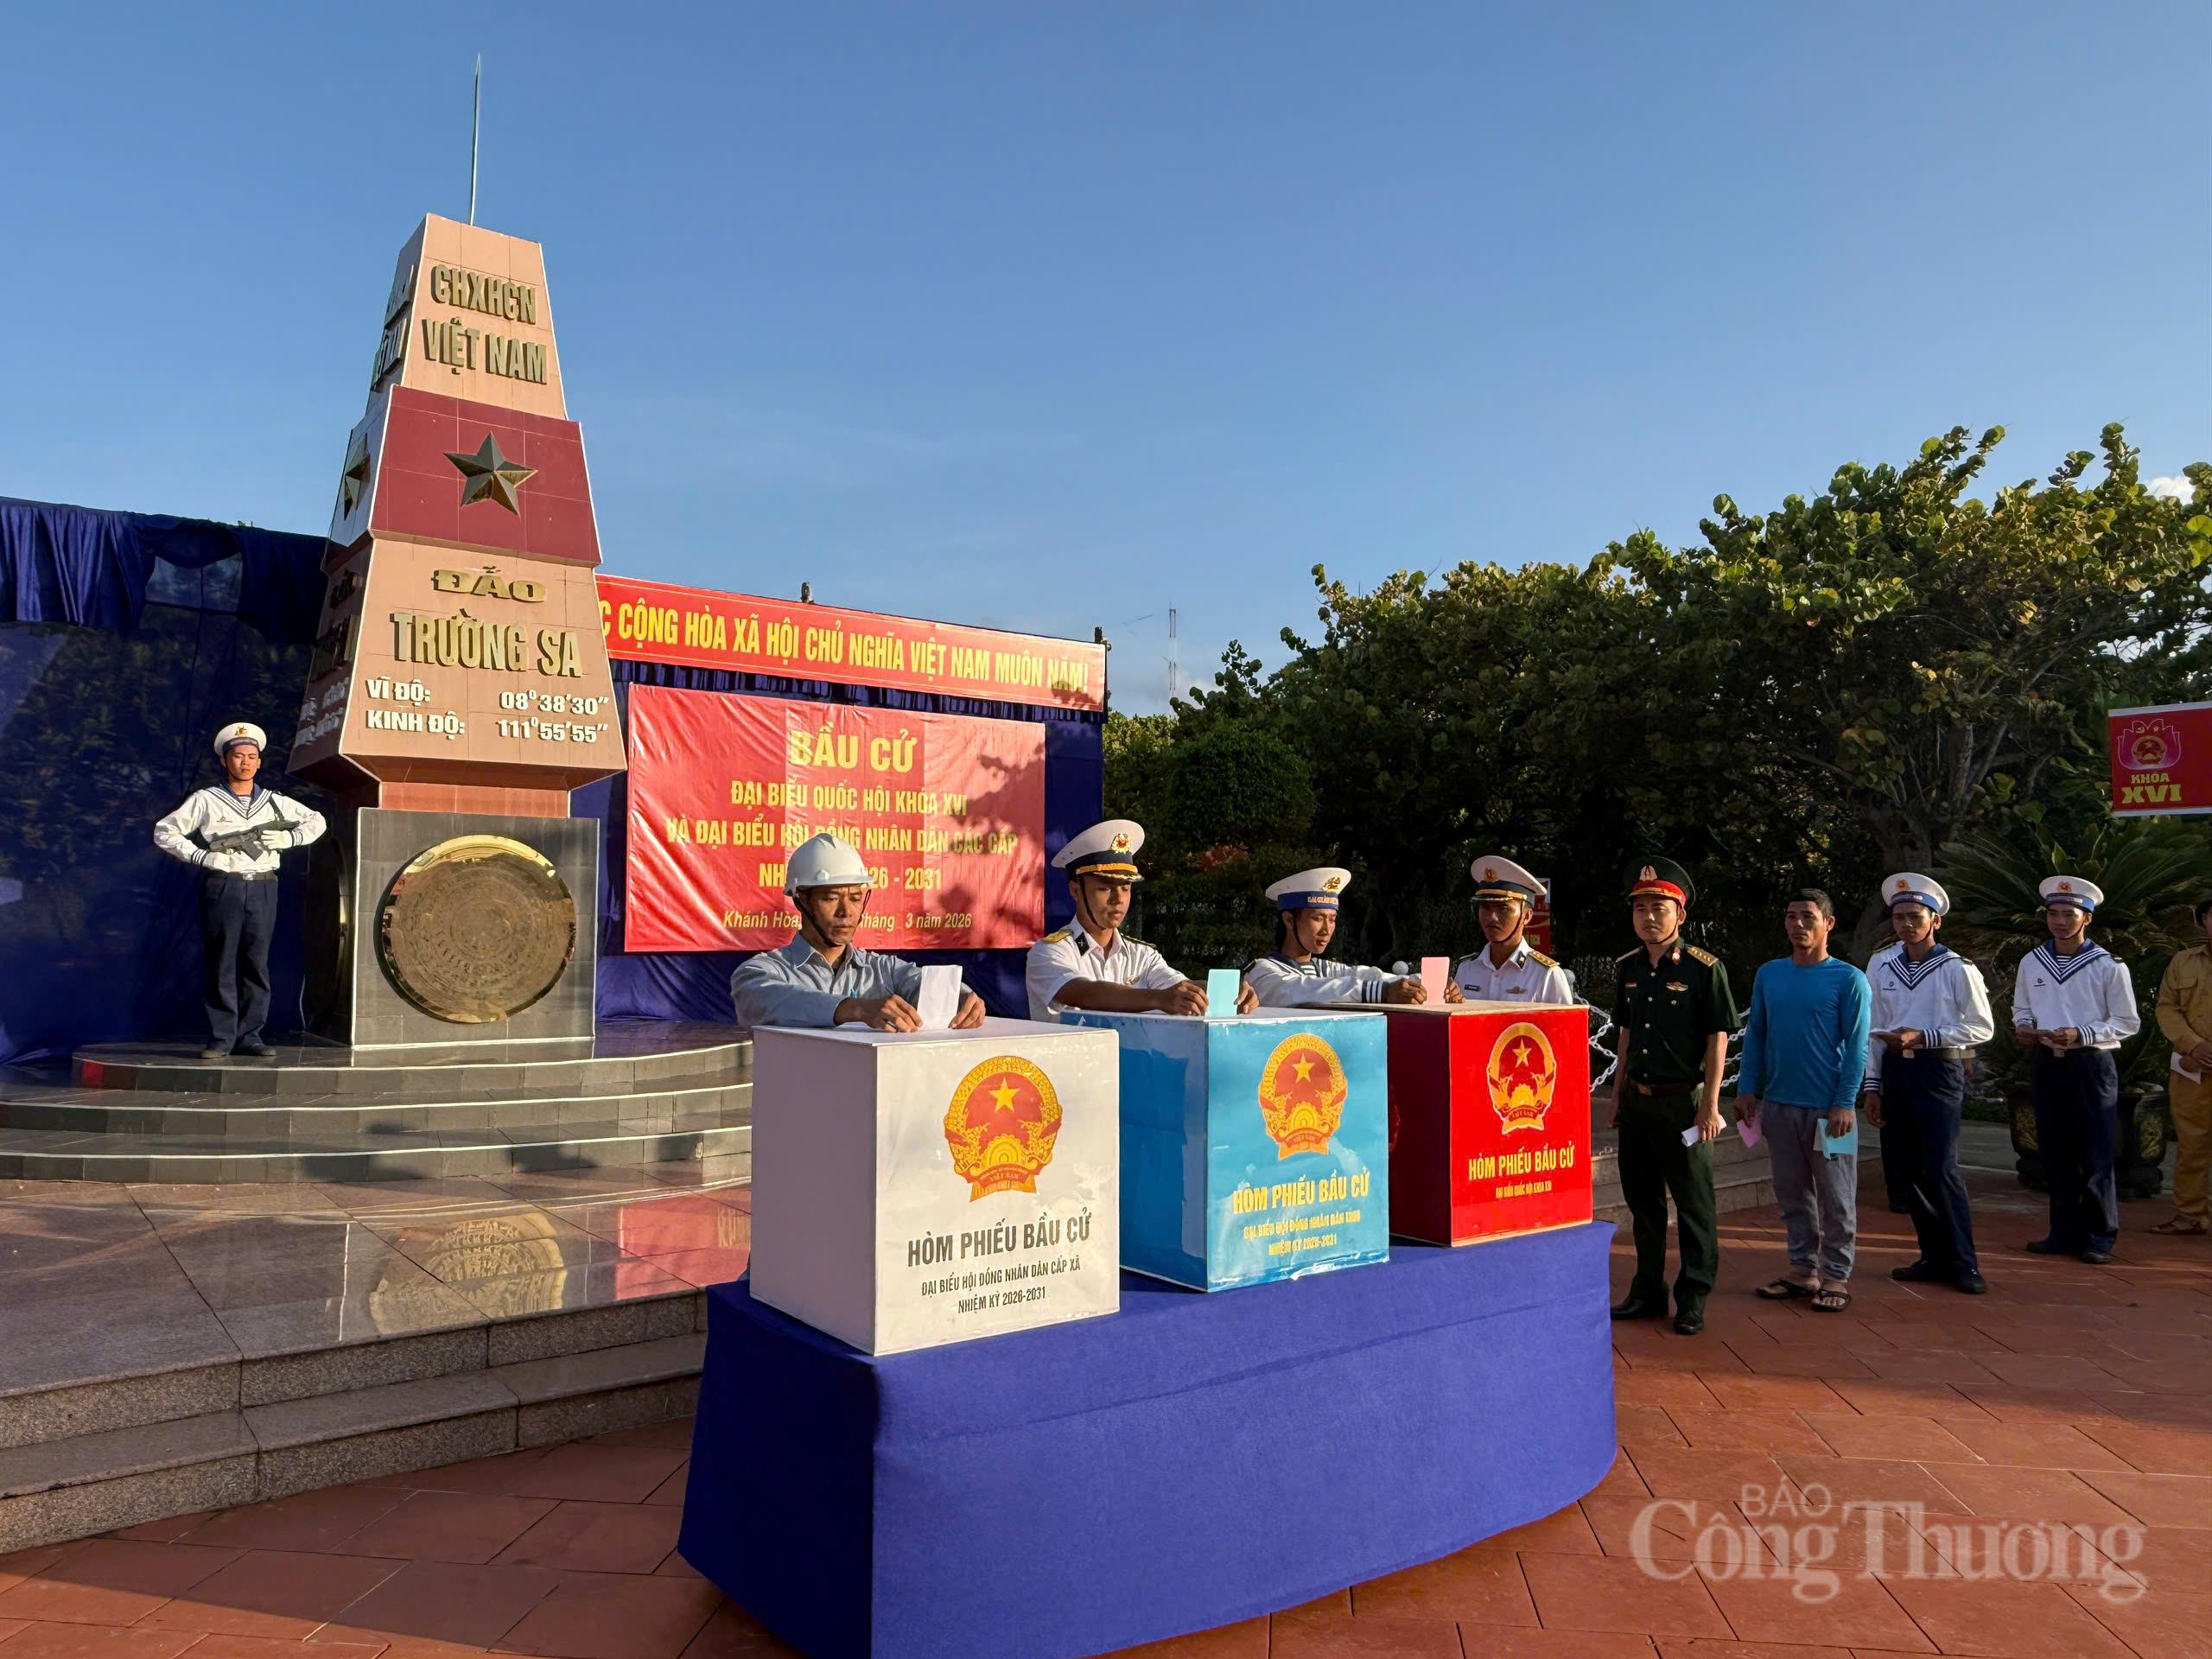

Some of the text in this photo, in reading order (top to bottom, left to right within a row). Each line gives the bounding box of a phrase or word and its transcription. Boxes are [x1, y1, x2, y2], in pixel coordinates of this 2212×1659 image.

[431, 264, 537, 325] CHXHCN
[422, 317, 480, 375] VIỆT
[486, 333, 548, 385] NAM
[431, 566, 546, 602] ĐẢO
[390, 608, 528, 671] TRƯỜNG
[537, 628, 582, 677] SA
[619, 598, 678, 649] CỘNG
[685, 604, 727, 650] HÒA
[733, 613, 760, 654] XÃ
[766, 617, 798, 665] HỘI
[805, 620, 843, 664] CHỦ
[849, 632, 905, 671] NGHĨA
[911, 637, 946, 681] VIỆT
[951, 646, 989, 681] NAM
[995, 650, 1042, 688] MUÔN
[1047, 655, 1089, 693] NĂM!
[365, 676, 390, 699] VĨ
[394, 679, 430, 706] ĐỘ:
[366, 709, 423, 732] KINH
[429, 711, 465, 740] ĐỘ:
[789, 721, 918, 772] BẦU CỬ
[731, 774, 967, 817] ĐẠI BIỂU QUỐC HỘI KHÓA XVI
[2121, 784, 2182, 804] XVI
[666, 814, 690, 843] VÀ
[696, 820, 727, 849] ĐẠI
[733, 813, 775, 846] BIỂU
[865, 823, 912, 851] NHÂN
[917, 825, 948, 852] DÂN
[953, 826, 983, 854] CÁC
[988, 825, 1018, 854] CẤP
[905, 868, 941, 889] 2031
[723, 910, 767, 928] Khánh
[906, 912, 912, 928] 3
[916, 912, 941, 928] năm
[945, 912, 972, 928] 2026
[1469, 1140, 1575, 1181] HÒM PHIẾU BẦU CỬ
[1232, 1166, 1370, 1214] HÒM PHIẾU BẦU CỬ
[907, 1206, 1092, 1268] HÒM PHIẾU BẦU CỬ
[922, 1281, 937, 1298] ĐẠI
[1070, 1255, 1081, 1271] XÃ
[958, 1294, 987, 1313] NHIỆM
